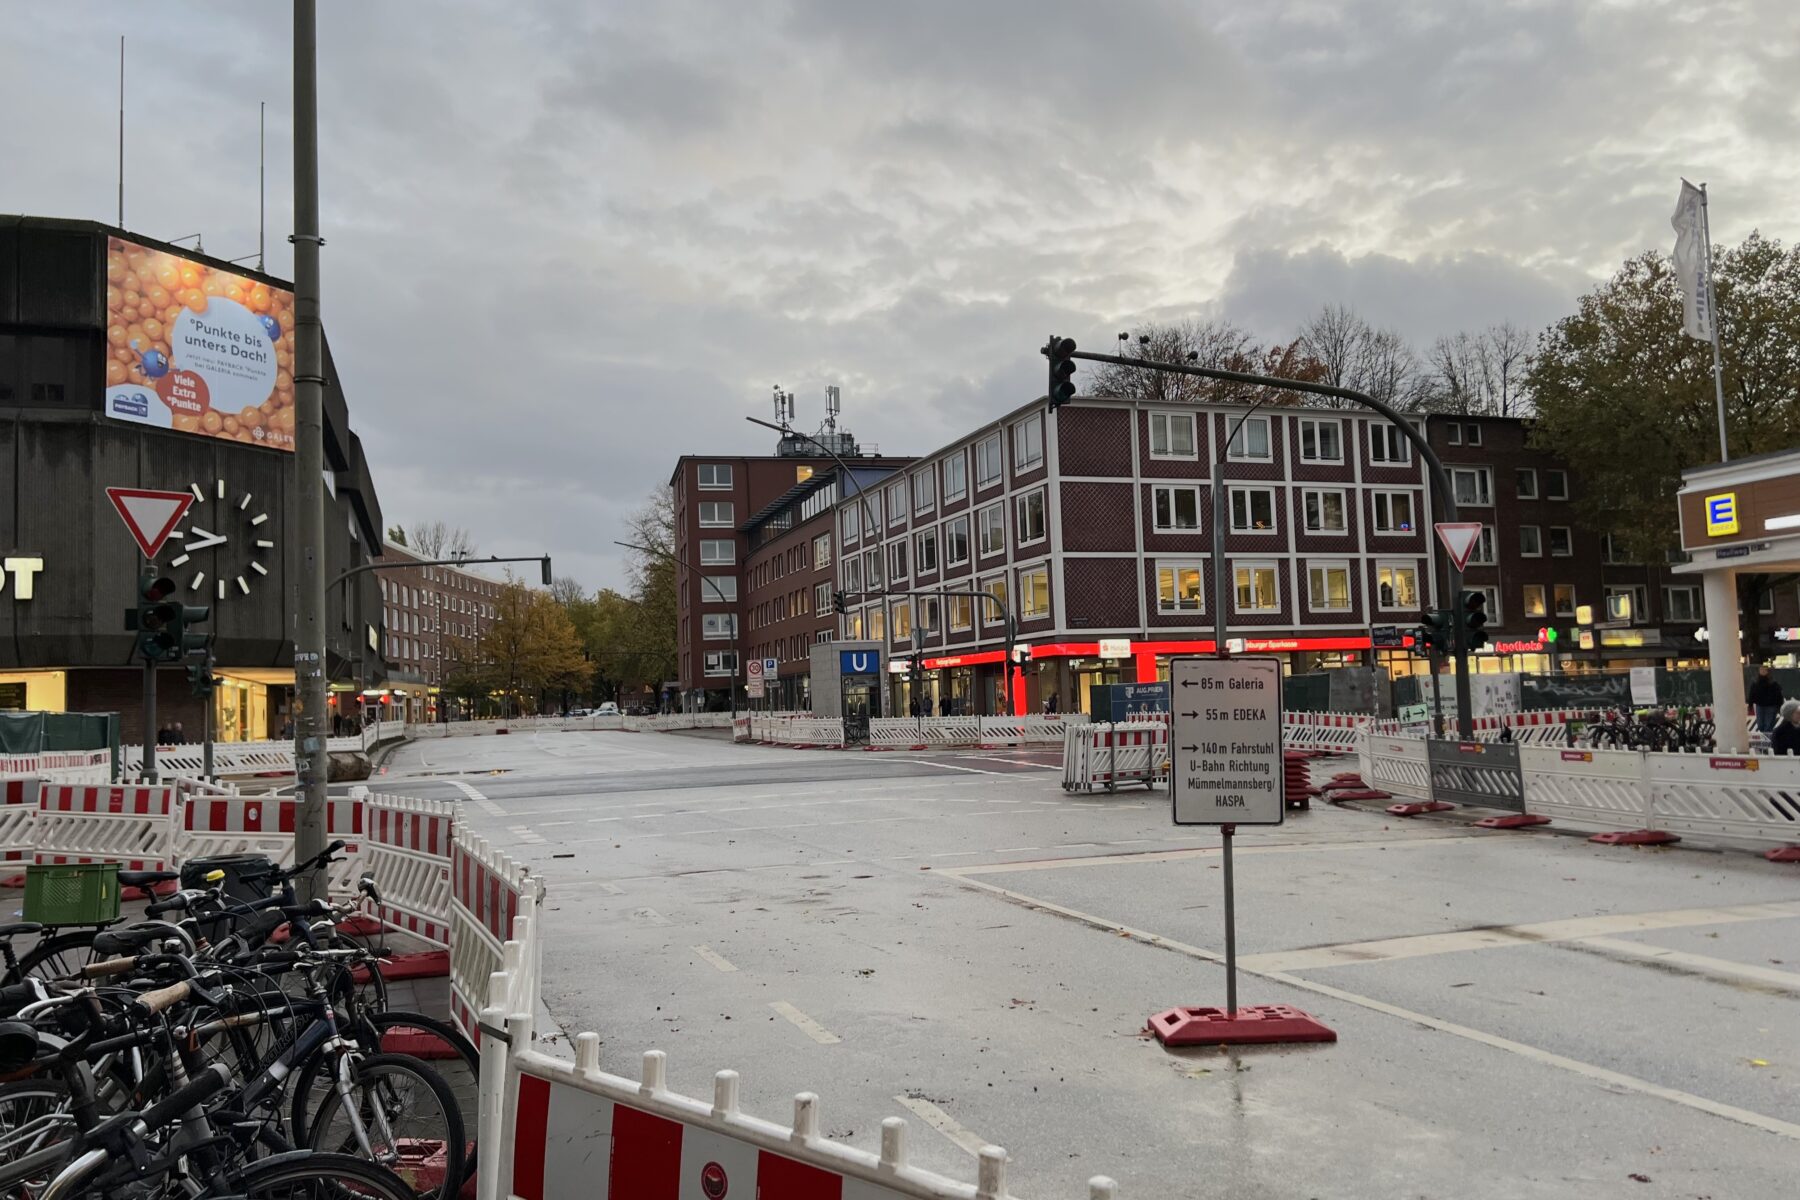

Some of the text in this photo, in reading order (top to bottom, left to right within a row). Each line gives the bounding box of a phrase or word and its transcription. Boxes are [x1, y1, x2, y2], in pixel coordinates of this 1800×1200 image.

[245, 334, 262, 348] bis
[185, 335, 267, 363] unters Dach!
[174, 374, 195, 387] Viele
[172, 386, 196, 399] Extra
[266, 431, 294, 443] GALER
[1710, 498, 1733, 524] E
[0, 557, 44, 600] T
[1495, 640, 1543, 653] Apotheke
[767, 660, 774, 668] P
[852, 653, 868, 672] U
[1228, 677, 1264, 690] Galeria
[1233, 709, 1267, 721] EDEKA
[1231, 742, 1274, 754] Fahrstuhl
[1190, 760, 1270, 775] U-Bahn Richtung
[1187, 777, 1276, 793] Mümmelmannsberg/
[1215, 795, 1245, 807] HASPA
